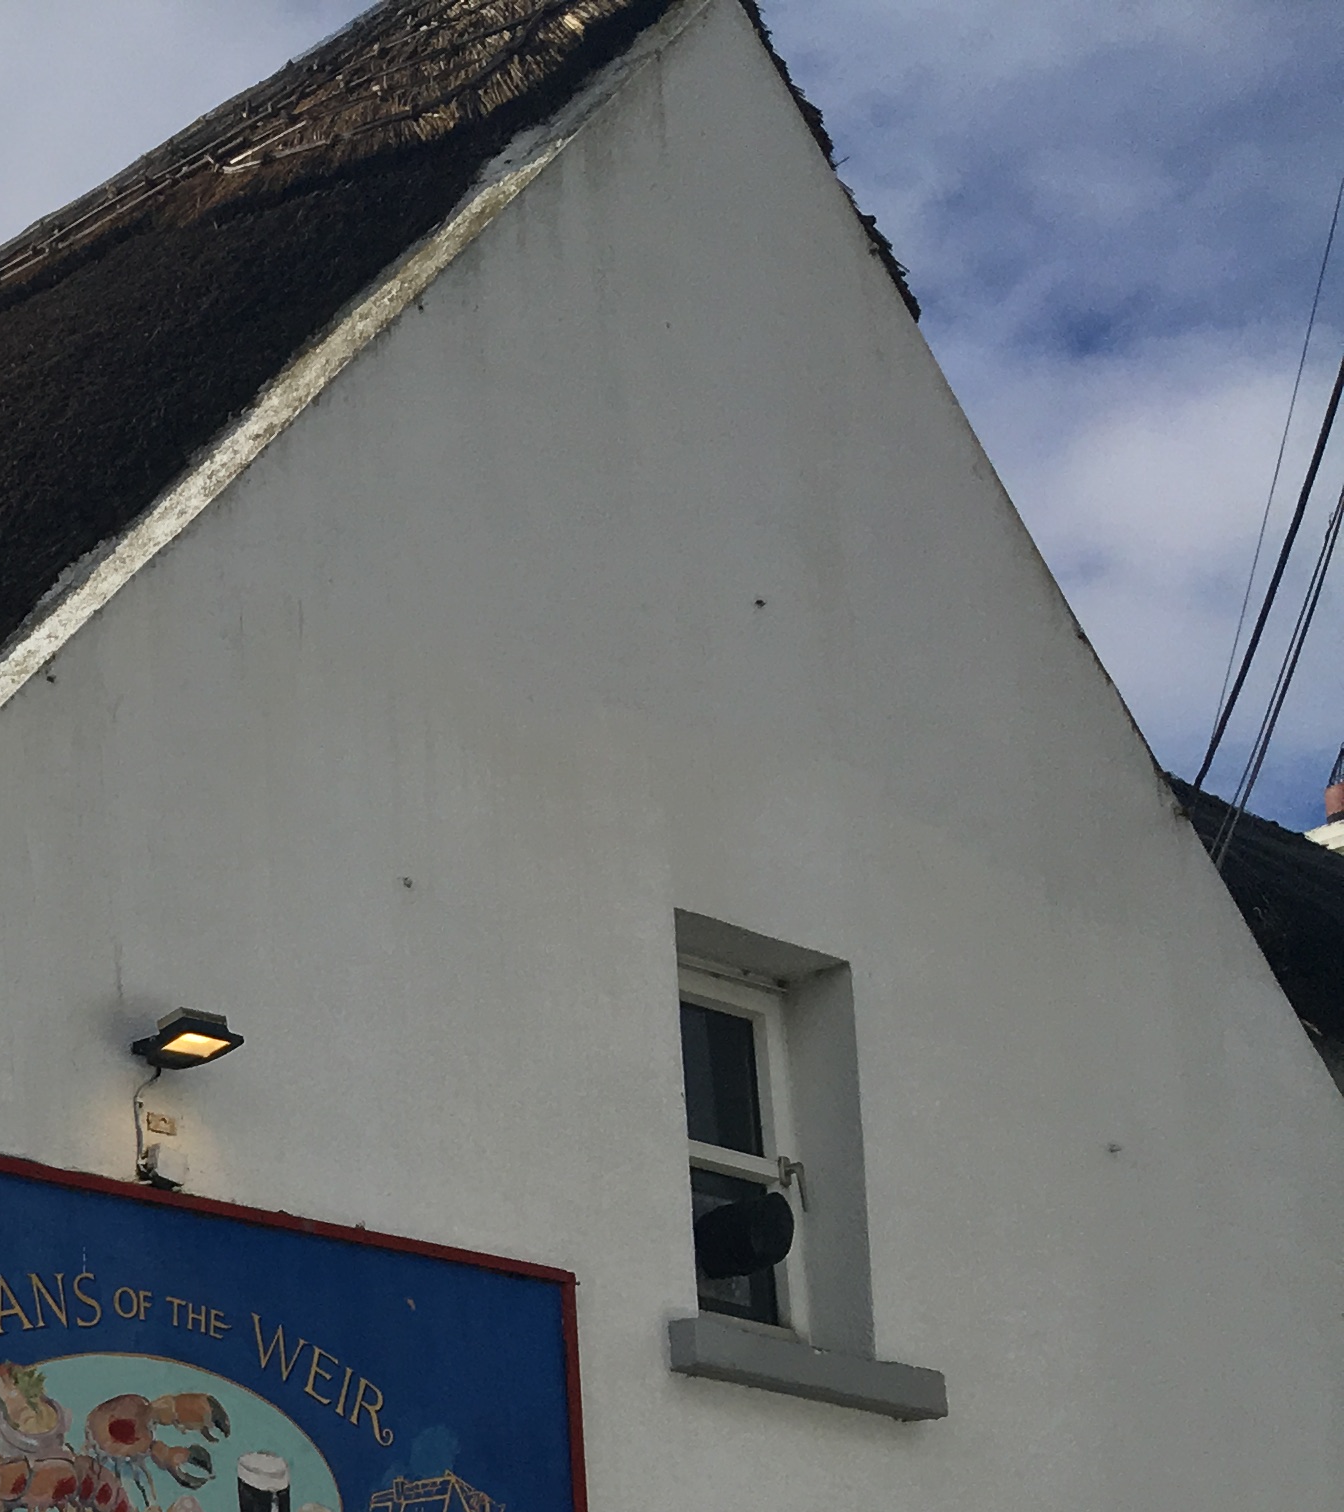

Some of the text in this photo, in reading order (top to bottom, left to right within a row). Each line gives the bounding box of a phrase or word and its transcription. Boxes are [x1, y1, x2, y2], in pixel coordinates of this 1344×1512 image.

[113, 1286, 153, 1321] OF
[165, 1296, 232, 1340] THE
[251, 1312, 394, 1447] WEIR
